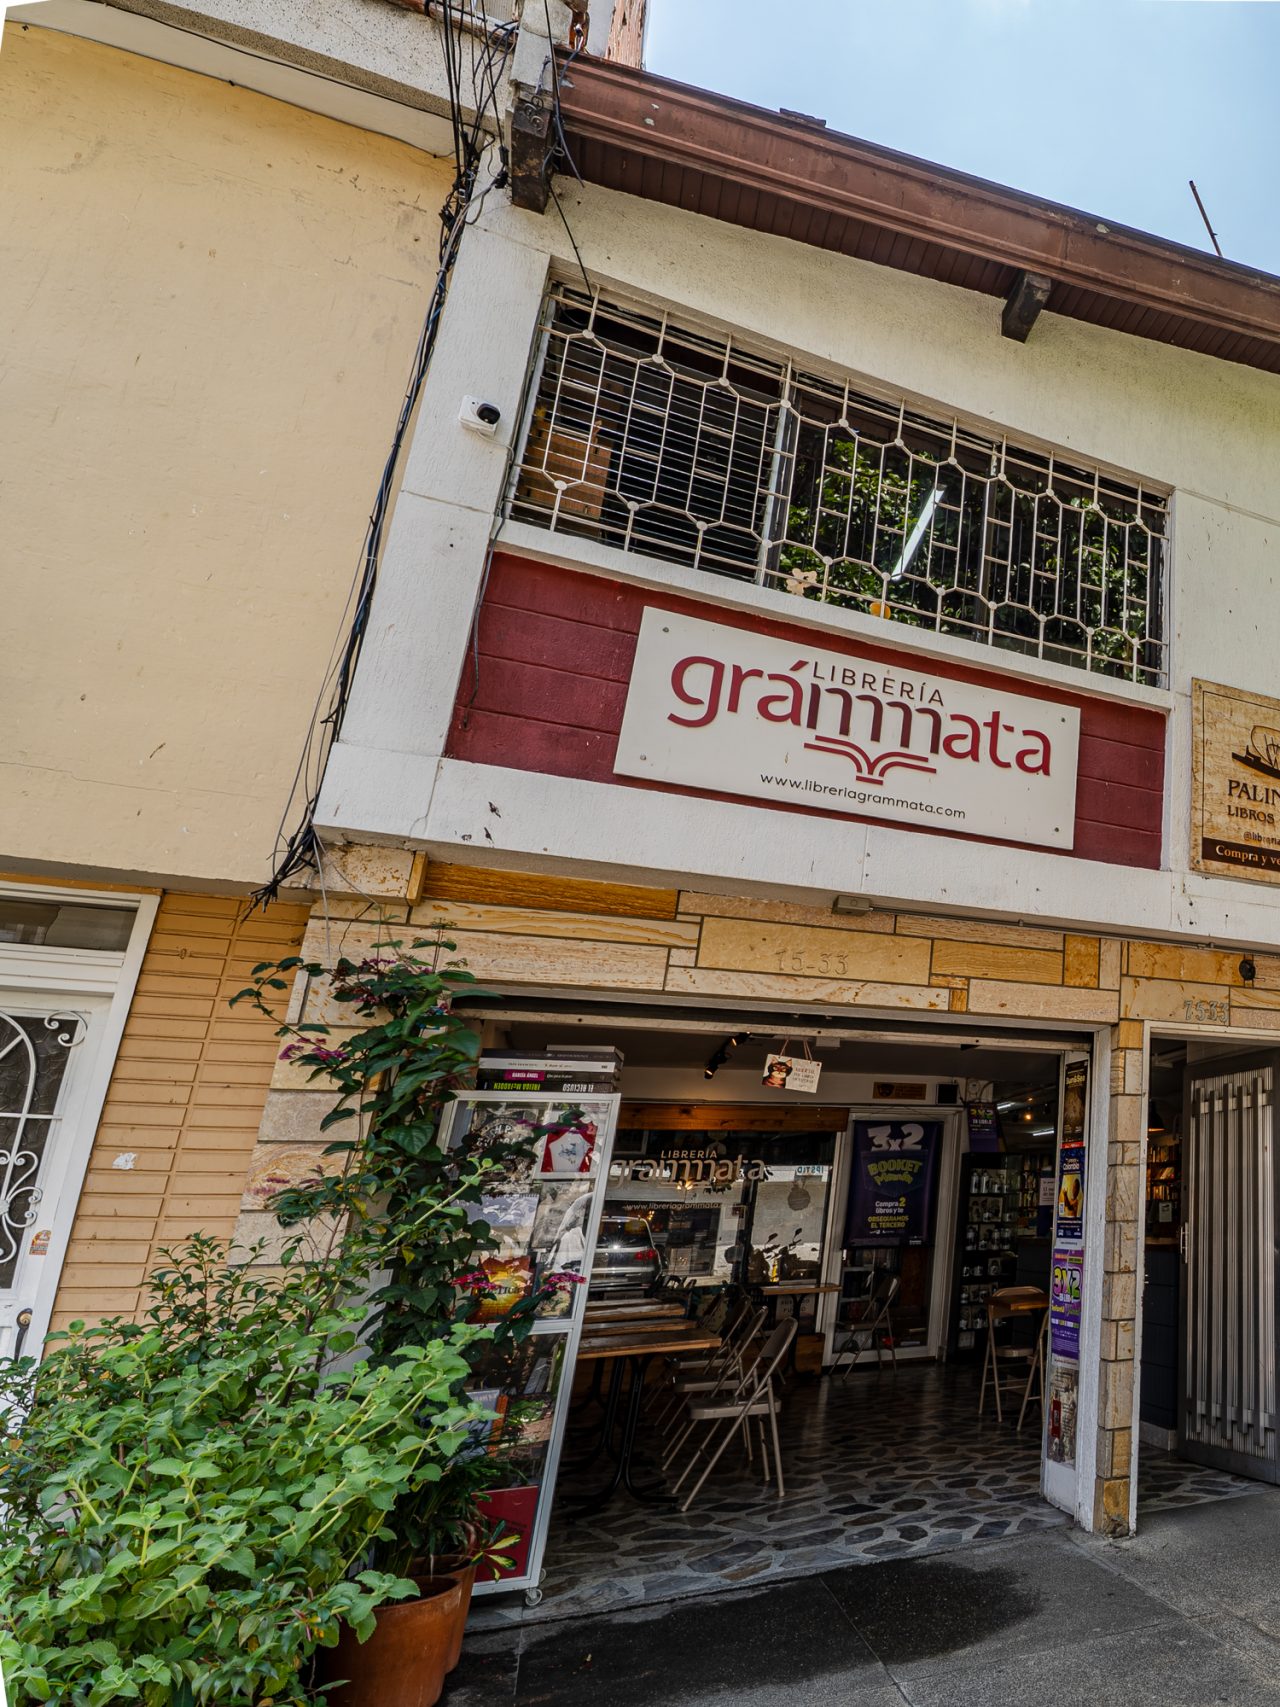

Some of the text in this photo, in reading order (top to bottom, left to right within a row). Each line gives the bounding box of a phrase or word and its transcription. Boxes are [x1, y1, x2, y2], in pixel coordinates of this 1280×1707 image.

[813, 661, 945, 706] LIBRERÍA
[760, 772, 966, 819] www.libreriagrammata.com
[1227, 805, 1275, 825] LIBROS
[1216, 845, 1258, 862] Compra
[1261, 855, 1268, 866] y
[867, 1122, 925, 1153] 3x2
[867, 1158, 924, 1177] BOOKET
[875, 1196, 908, 1208] Compra 2
